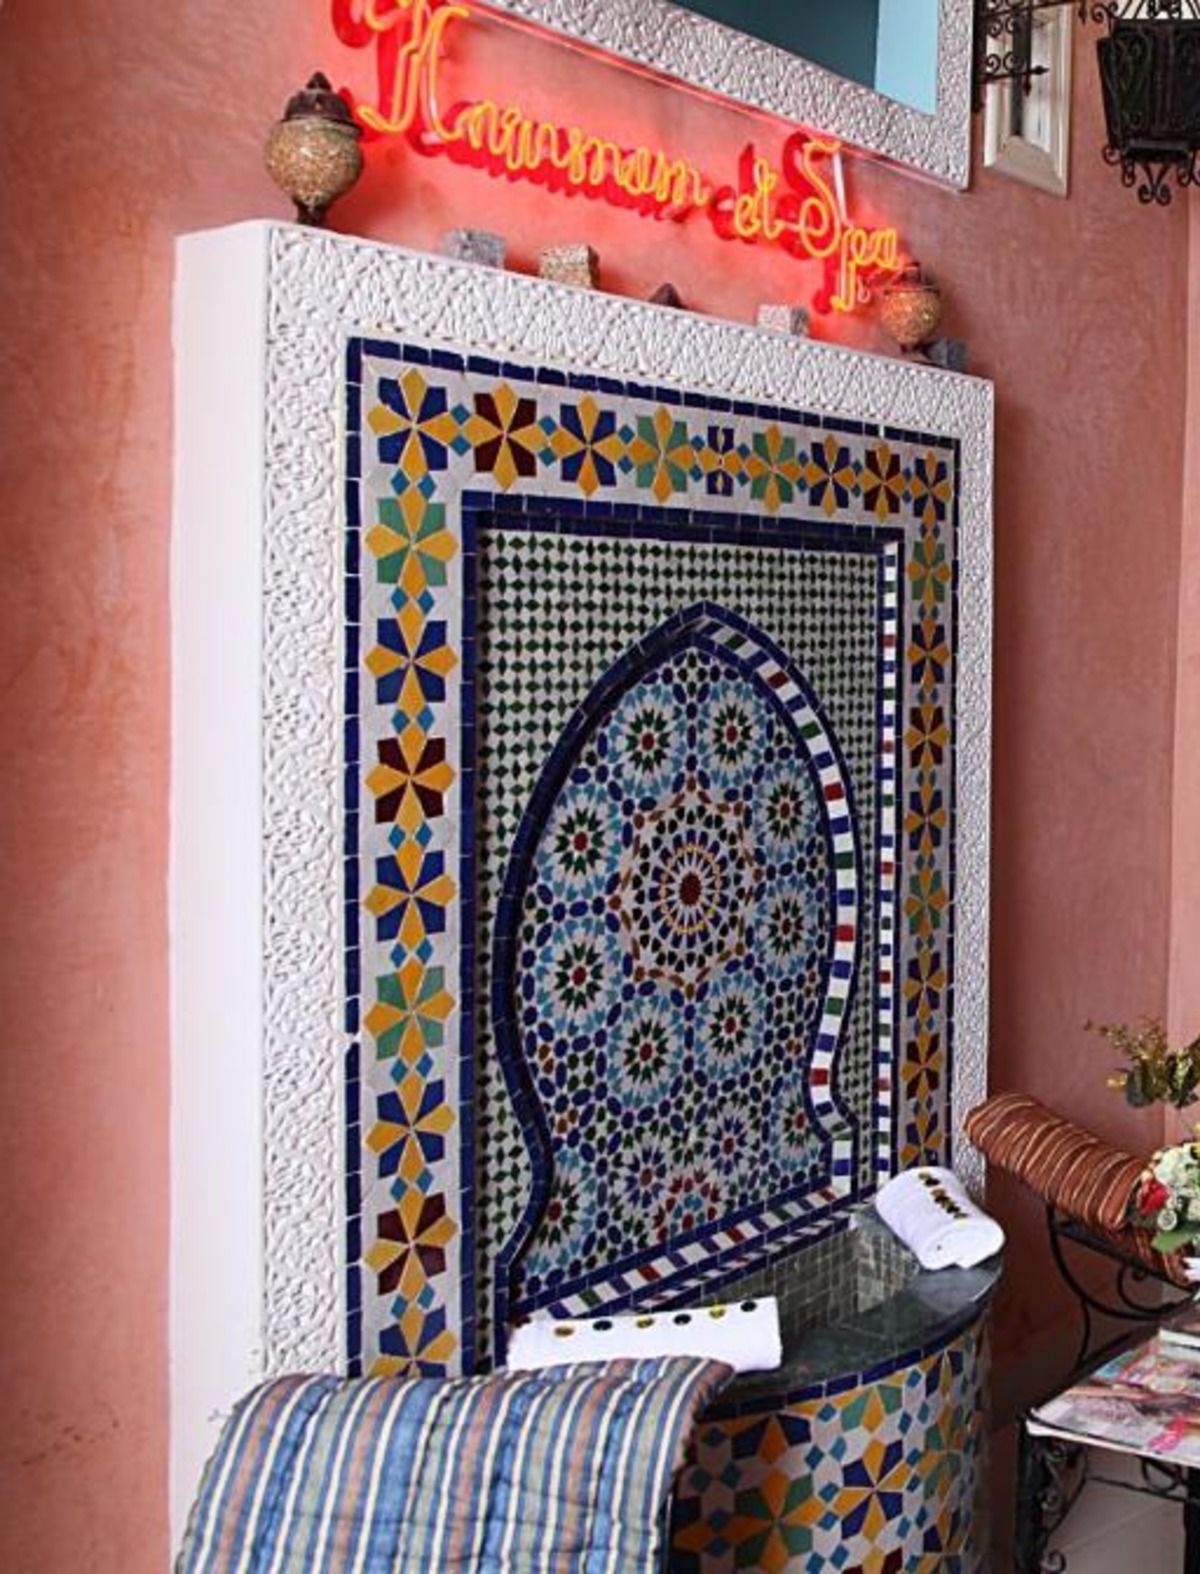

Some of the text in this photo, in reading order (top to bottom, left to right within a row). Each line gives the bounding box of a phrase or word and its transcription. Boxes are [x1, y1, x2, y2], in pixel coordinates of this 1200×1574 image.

[358, 0, 904, 312] Hammam et Spa
